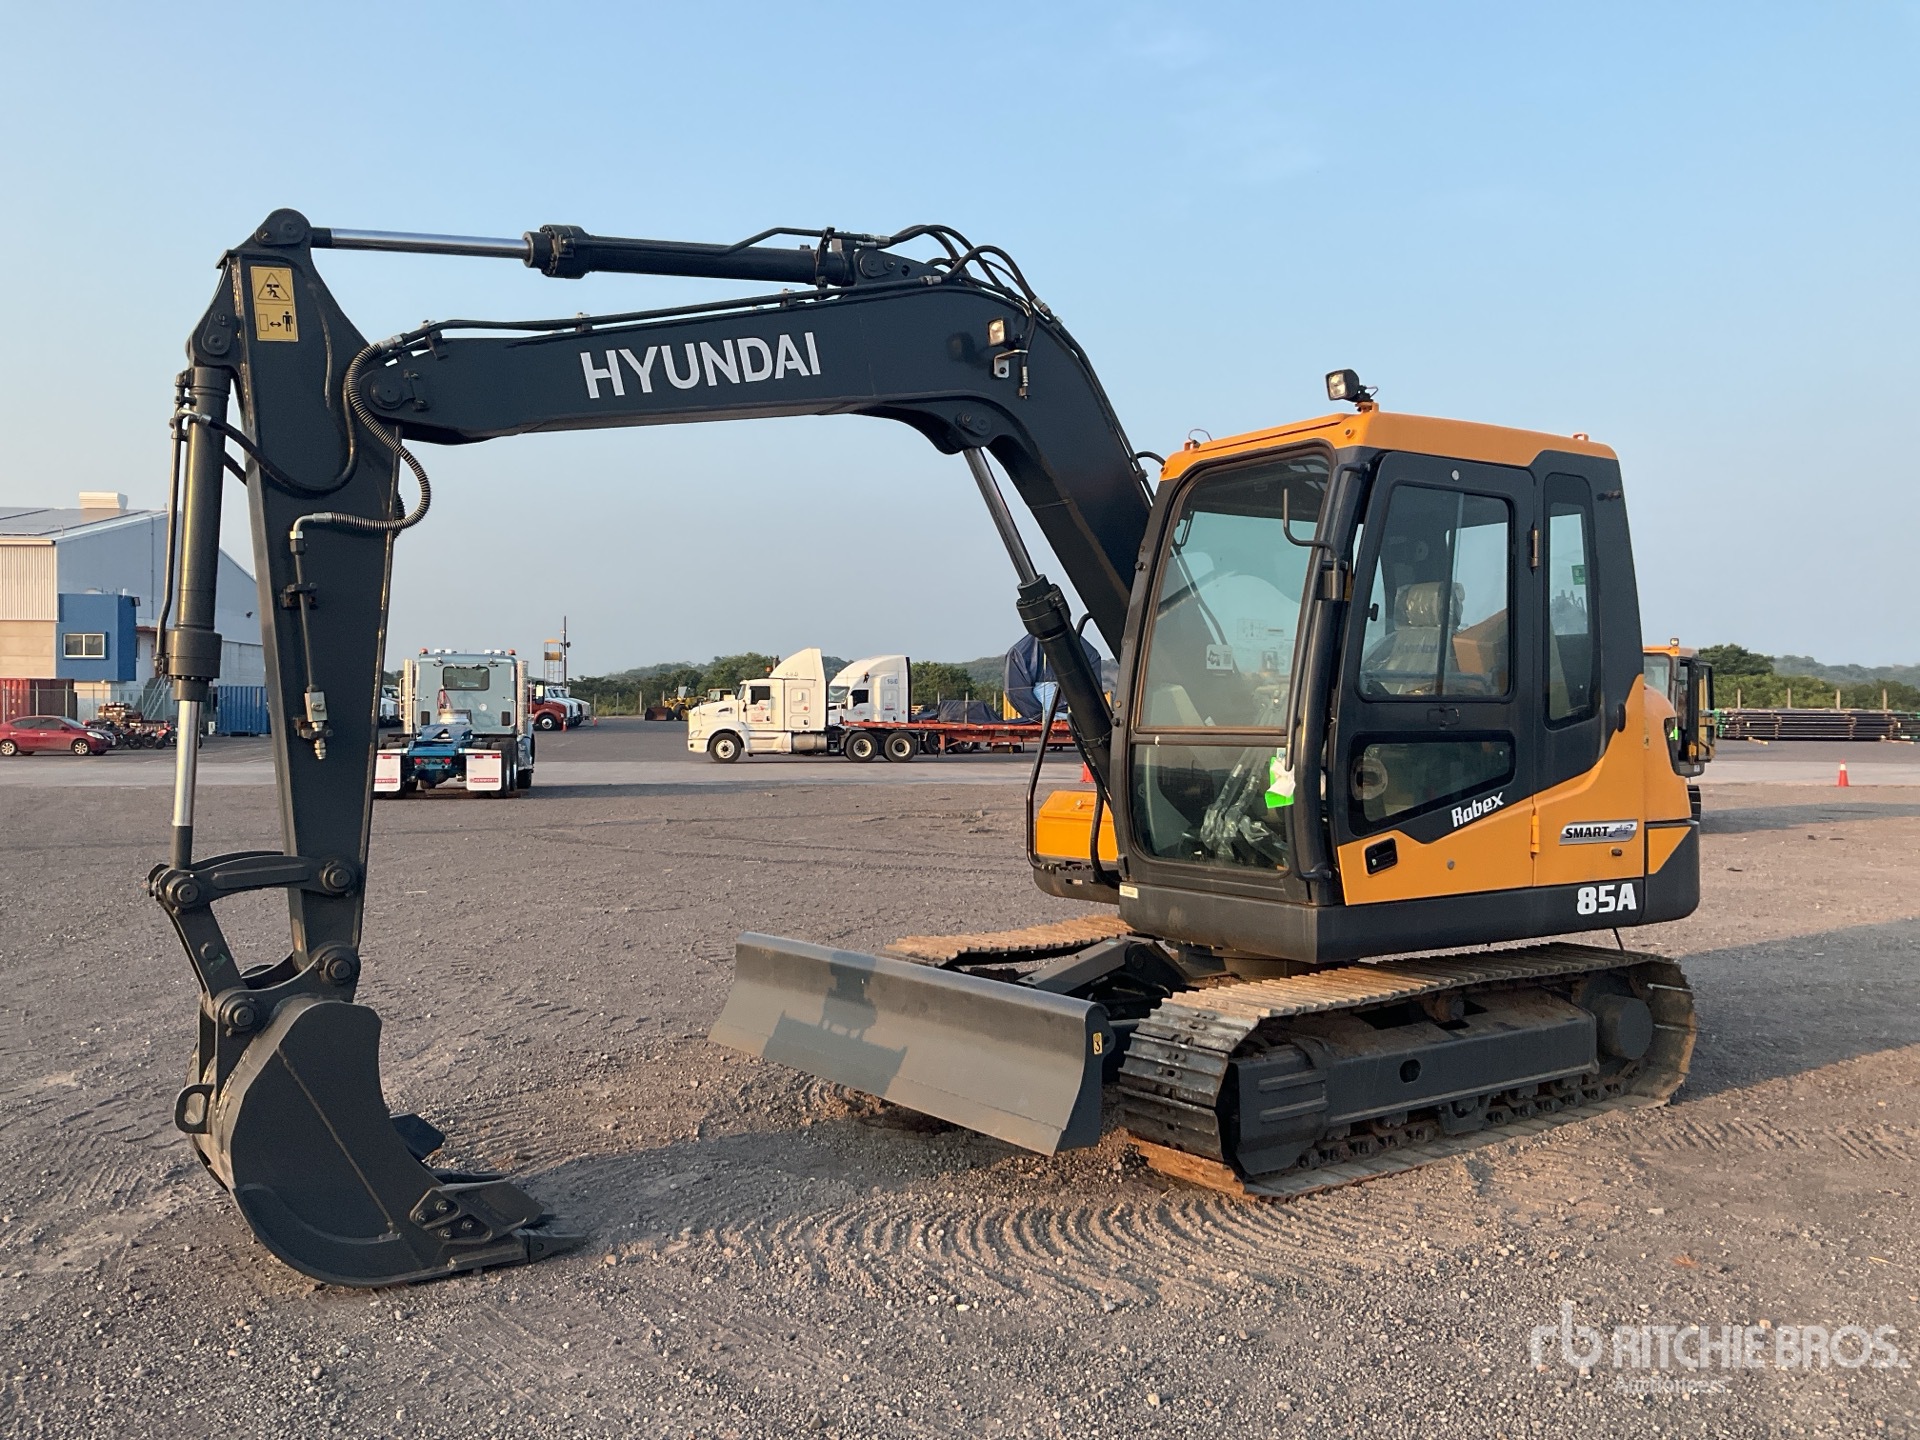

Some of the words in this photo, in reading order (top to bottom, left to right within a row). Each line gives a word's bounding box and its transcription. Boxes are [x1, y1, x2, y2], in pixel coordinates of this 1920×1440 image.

[580, 332, 821, 398] HYUNDAI
[1451, 791, 1504, 827] Robex
[1565, 827, 1609, 838] SMART
[1577, 883, 1636, 915] 85A
